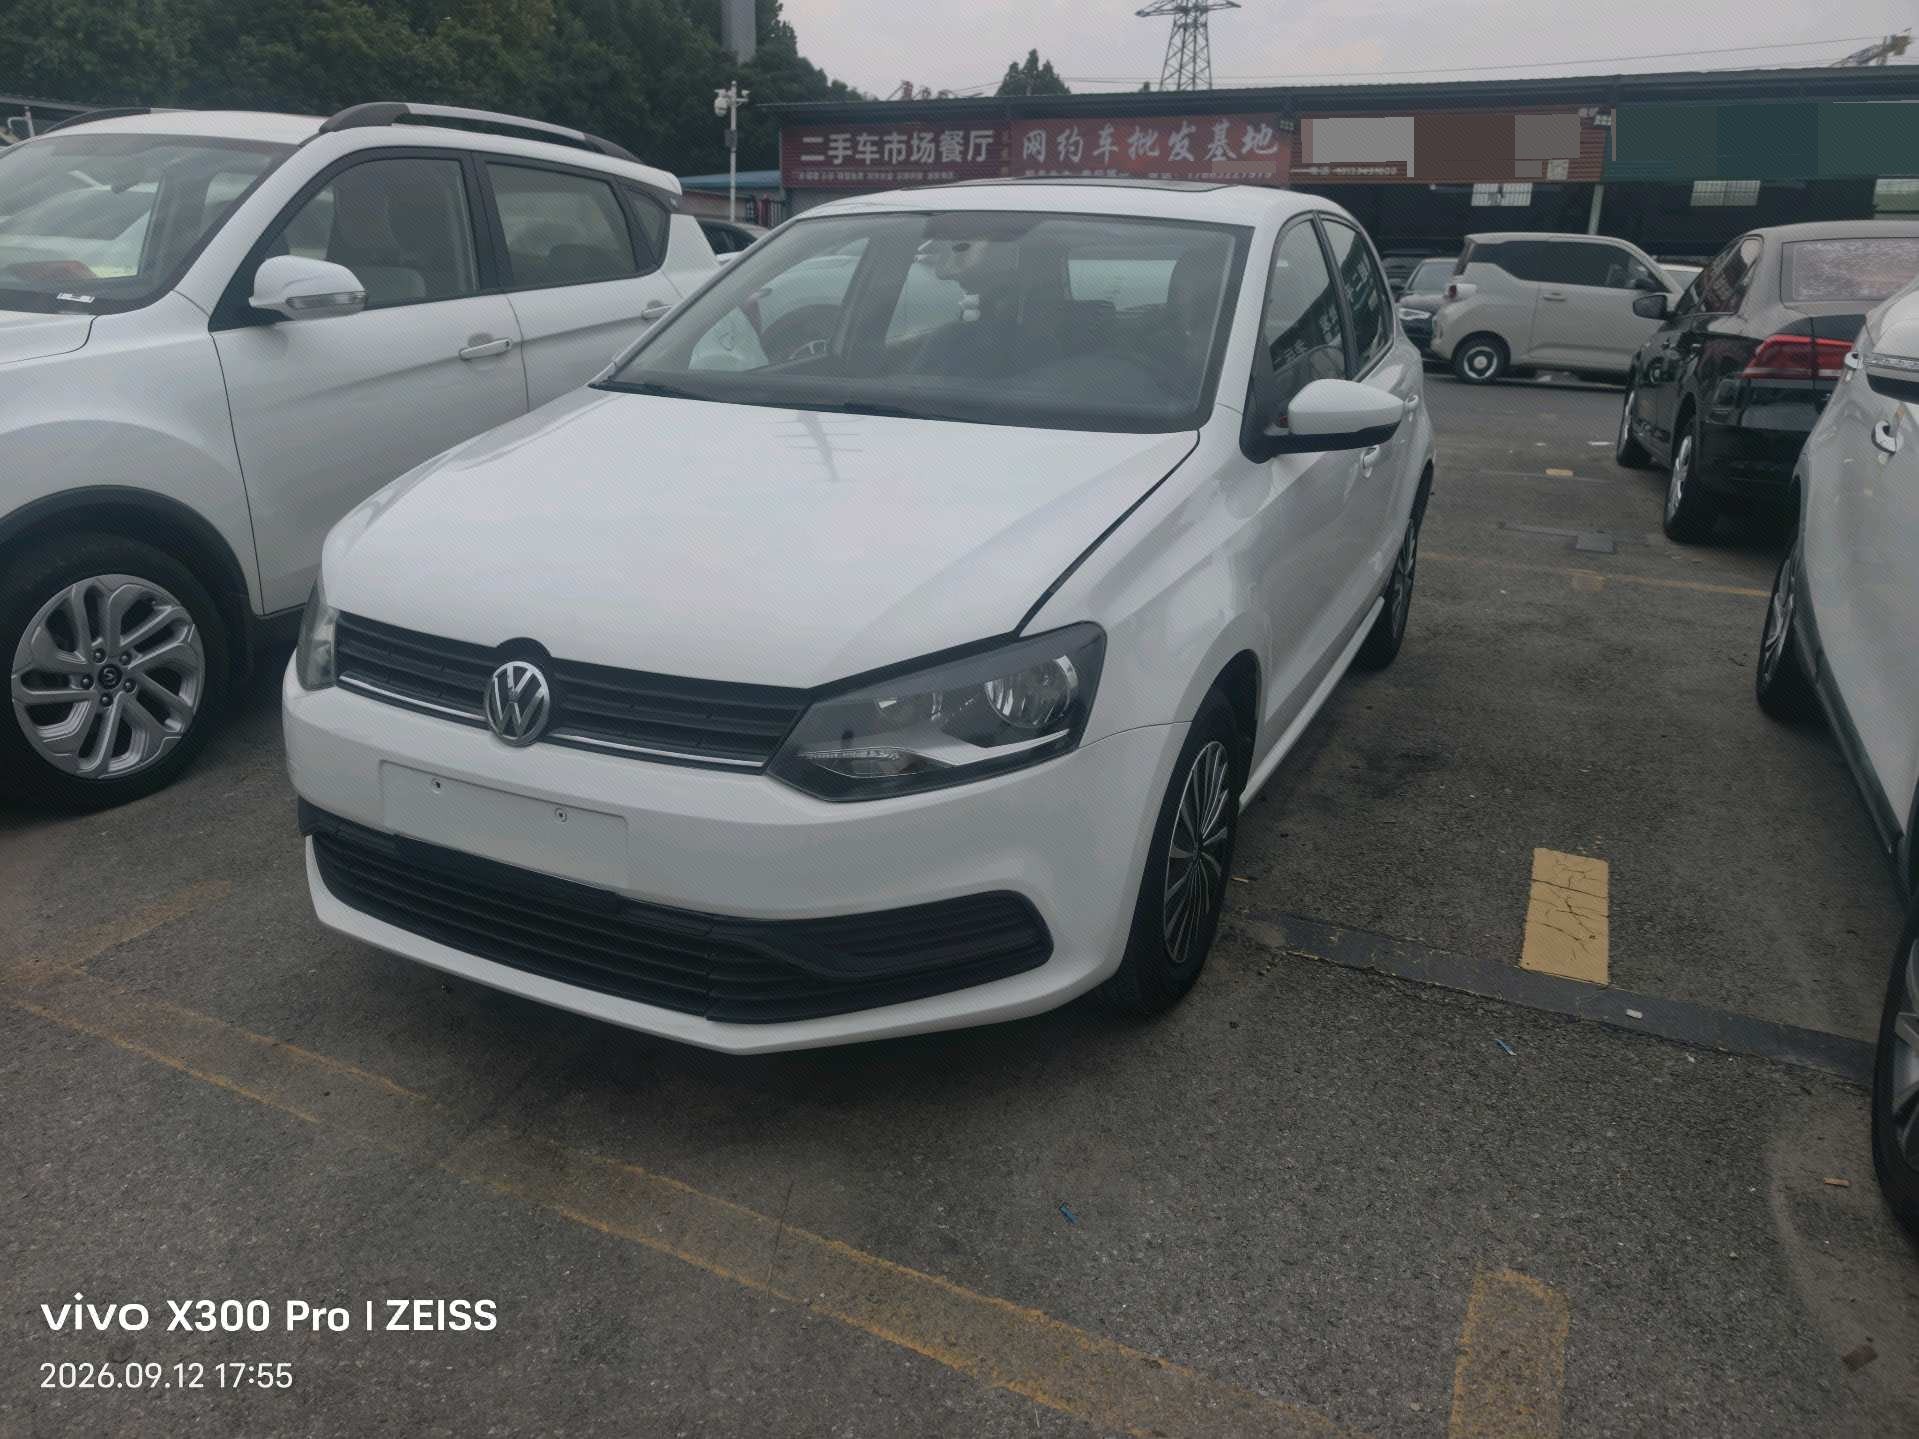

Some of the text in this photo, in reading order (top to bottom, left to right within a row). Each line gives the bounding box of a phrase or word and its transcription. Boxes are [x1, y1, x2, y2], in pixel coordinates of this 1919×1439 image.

[800, 129, 995, 165] 二手车市场餐厅
[1022, 119, 1278, 164] 网约车批发基地
